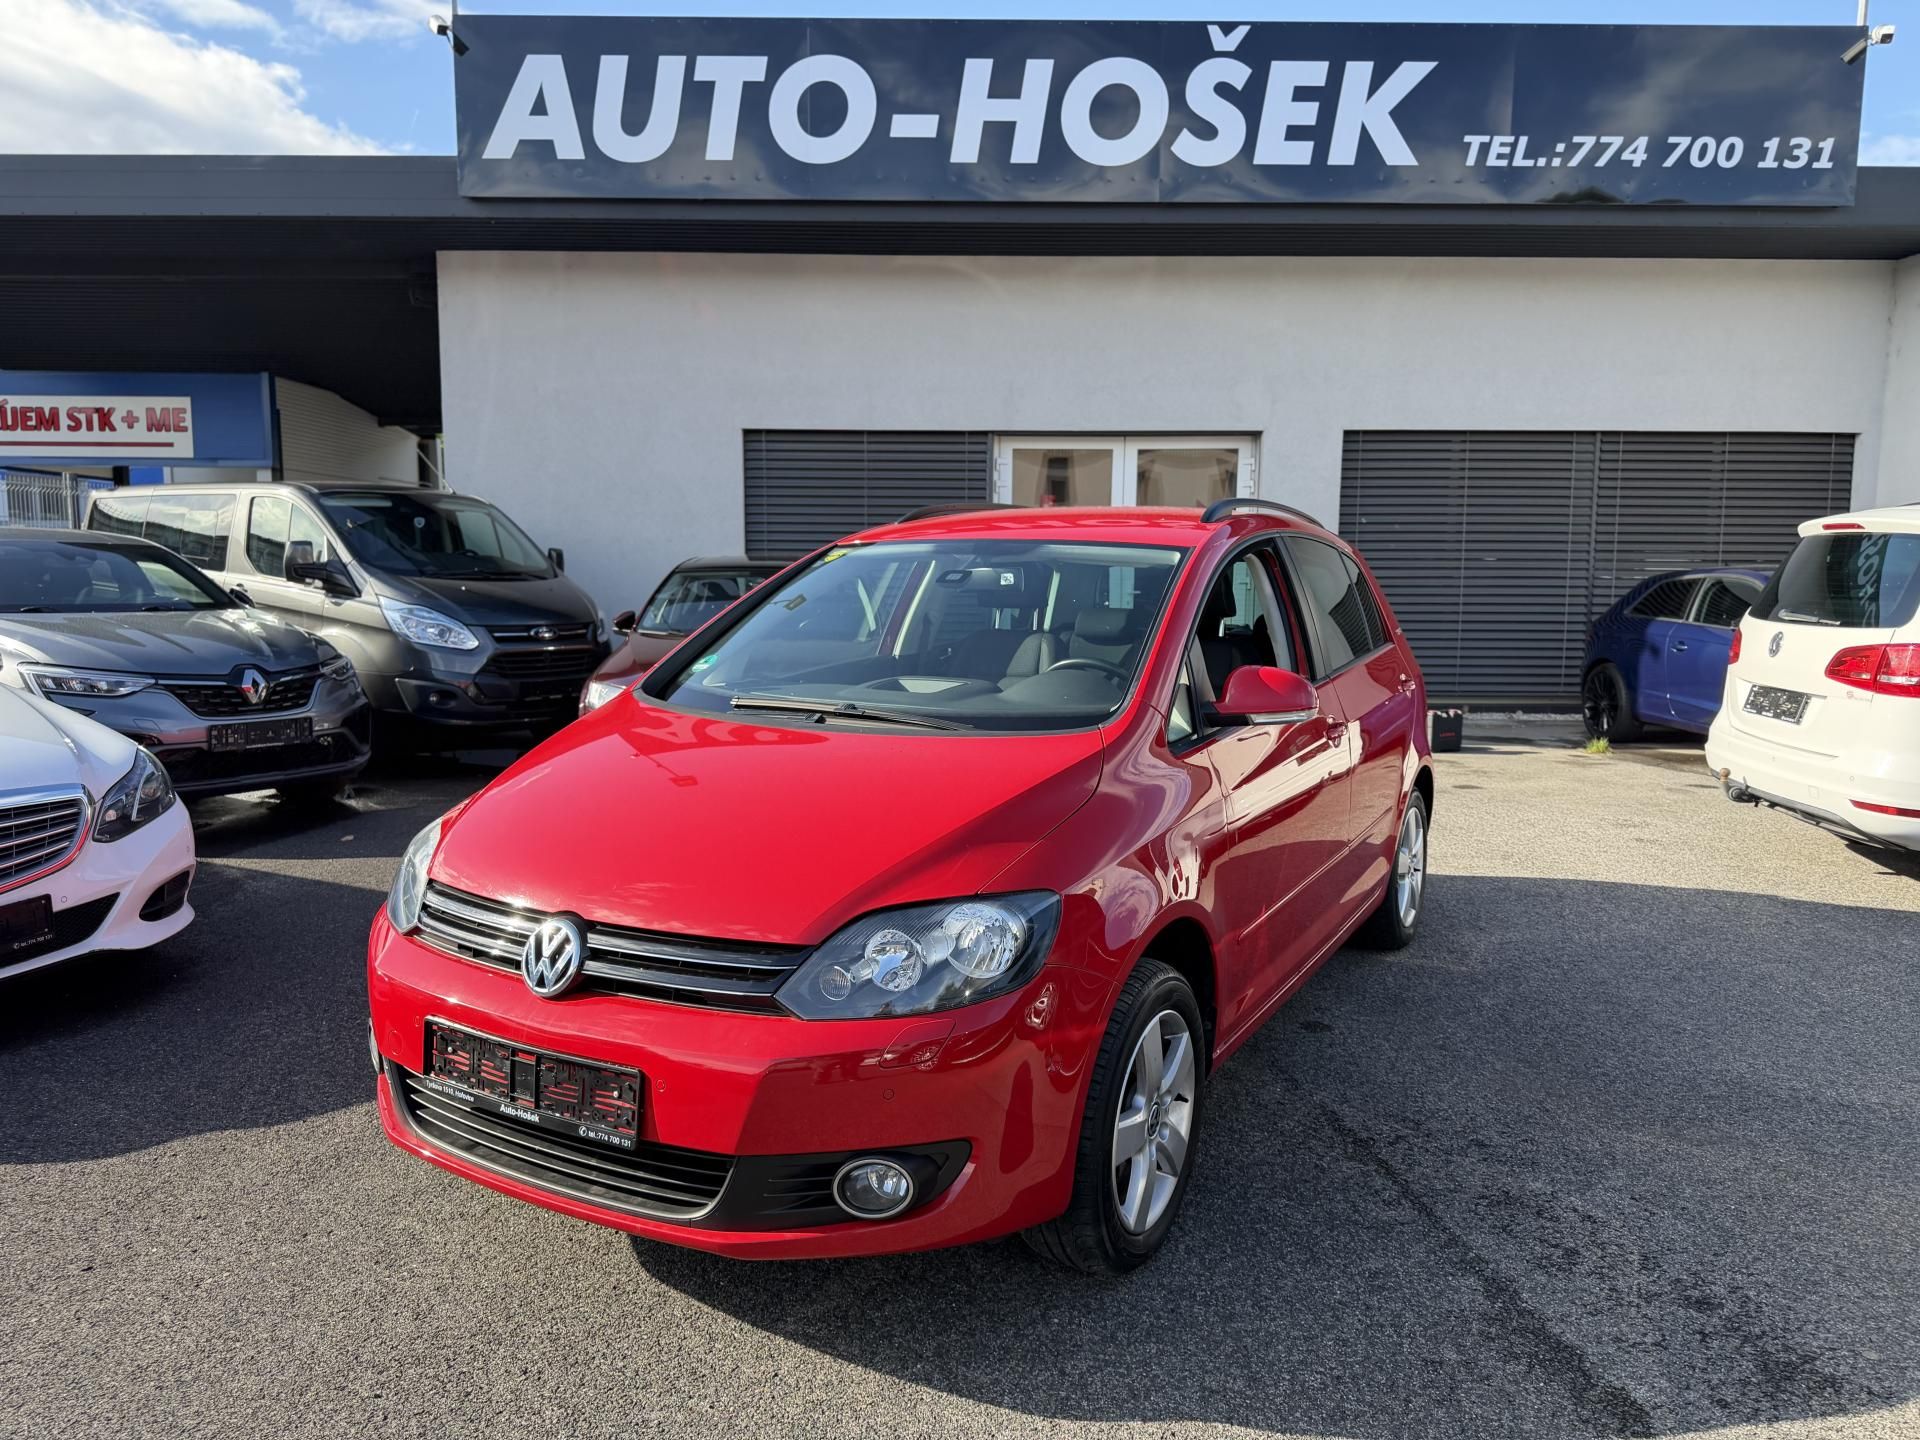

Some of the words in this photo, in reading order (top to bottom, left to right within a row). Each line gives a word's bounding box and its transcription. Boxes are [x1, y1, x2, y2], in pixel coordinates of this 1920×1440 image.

[482, 25, 1437, 167] AUTO-HOŠEK
[1463, 135, 1648, 168] TEL.:774
[1662, 136, 1744, 169] 700
[1757, 137, 1835, 169] 131
[66, 406, 117, 432] STK
[121, 410, 140, 429] +
[145, 407, 189, 432] ME
[500, 1104, 540, 1122] Auto-Hošek
[609, 1135, 620, 1145] 700
[621, 1139, 631, 1148] 131
